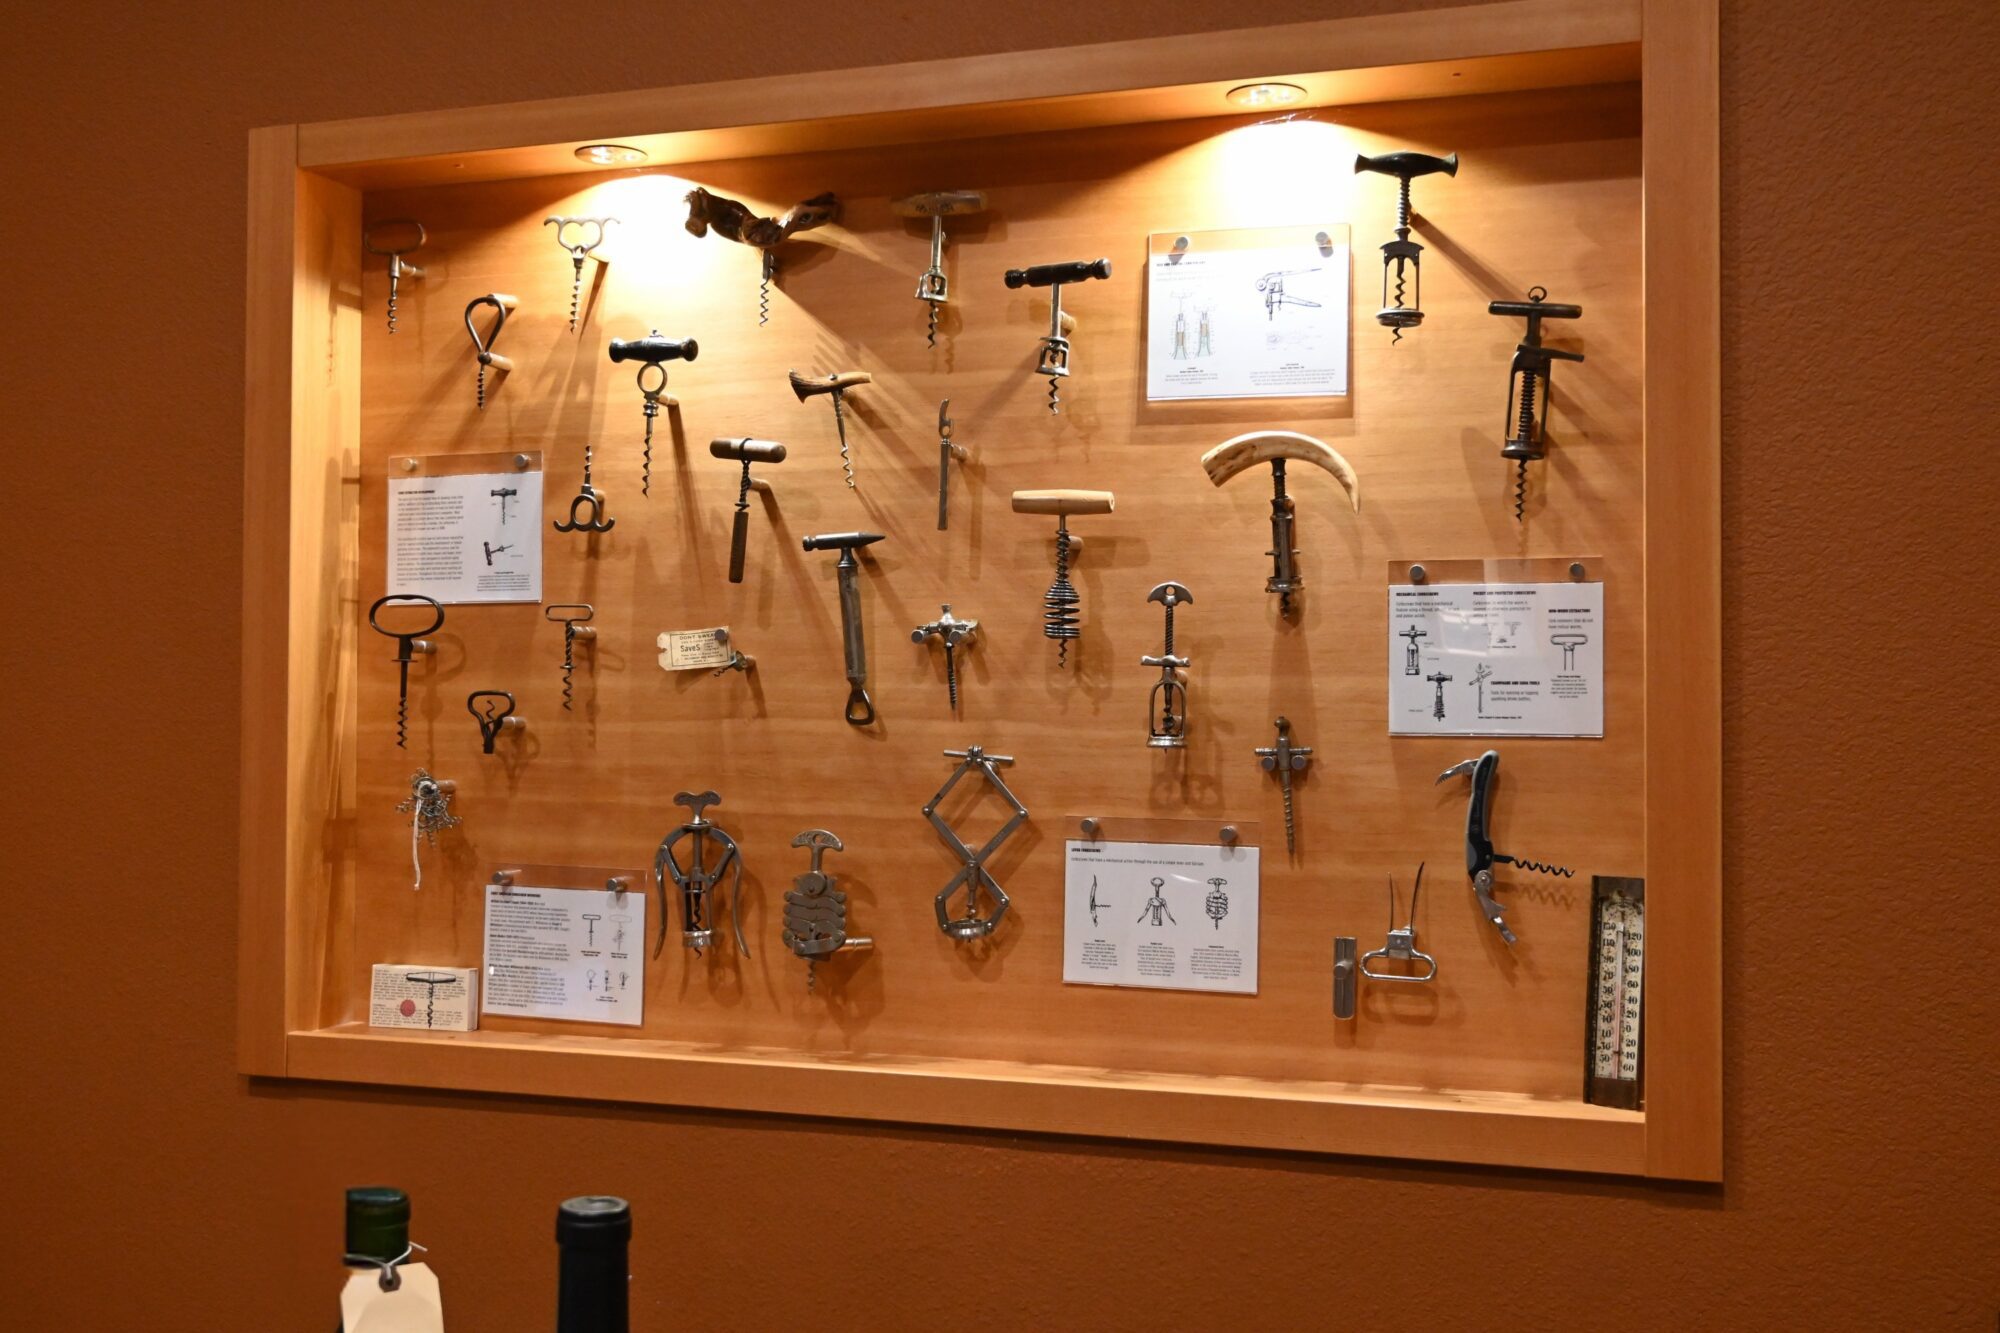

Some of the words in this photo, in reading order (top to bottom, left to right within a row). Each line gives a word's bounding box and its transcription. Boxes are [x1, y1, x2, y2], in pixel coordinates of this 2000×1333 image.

[1628, 932, 1642, 941] 120
[1604, 972, 1614, 980] 70
[1627, 996, 1637, 1004] 40
[1602, 1029, 1611, 1037] 10
[1625, 1052, 1635, 1060] 40
